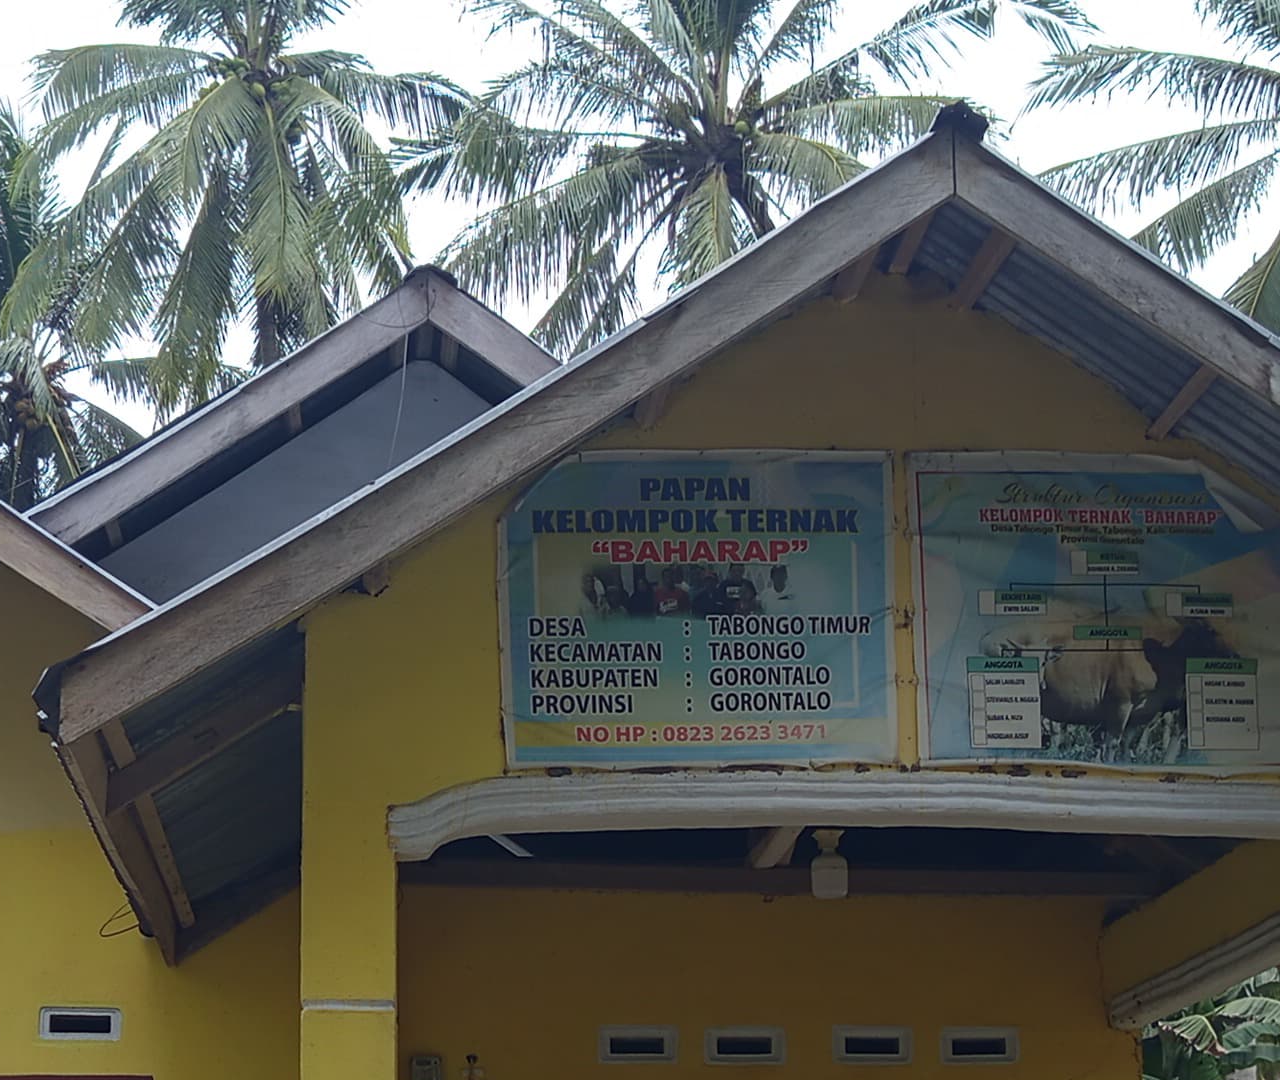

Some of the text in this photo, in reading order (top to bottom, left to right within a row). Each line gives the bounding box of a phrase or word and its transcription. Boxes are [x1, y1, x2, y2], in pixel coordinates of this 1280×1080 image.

[639, 477, 750, 501] PAPAN
[532, 509, 858, 533] KELOMPOK TERNAK
[979, 508, 1063, 522] KELOMPOK
[1068, 509, 1131, 524] TERNAK
[592, 540, 808, 562] “BAHARAP”
[529, 617, 586, 637] DESA
[708, 617, 804, 636] TABONGO
[809, 616, 871, 634] TIMUR
[530, 643, 662, 662] KECAMATAN
[709, 642, 805, 661] TABONGO
[530, 668, 658, 688] KABUPATEN
[710, 666, 830, 686] GORONTALO
[532, 694, 633, 714] PROVINSI
[710, 692, 831, 711] GORONTALO
[576, 727, 609, 742] NO
[616, 726, 645, 742] HP
[663, 726, 714, 742] 0823
[721, 725, 771, 741] 2623
[778, 724, 827, 740] 3471
